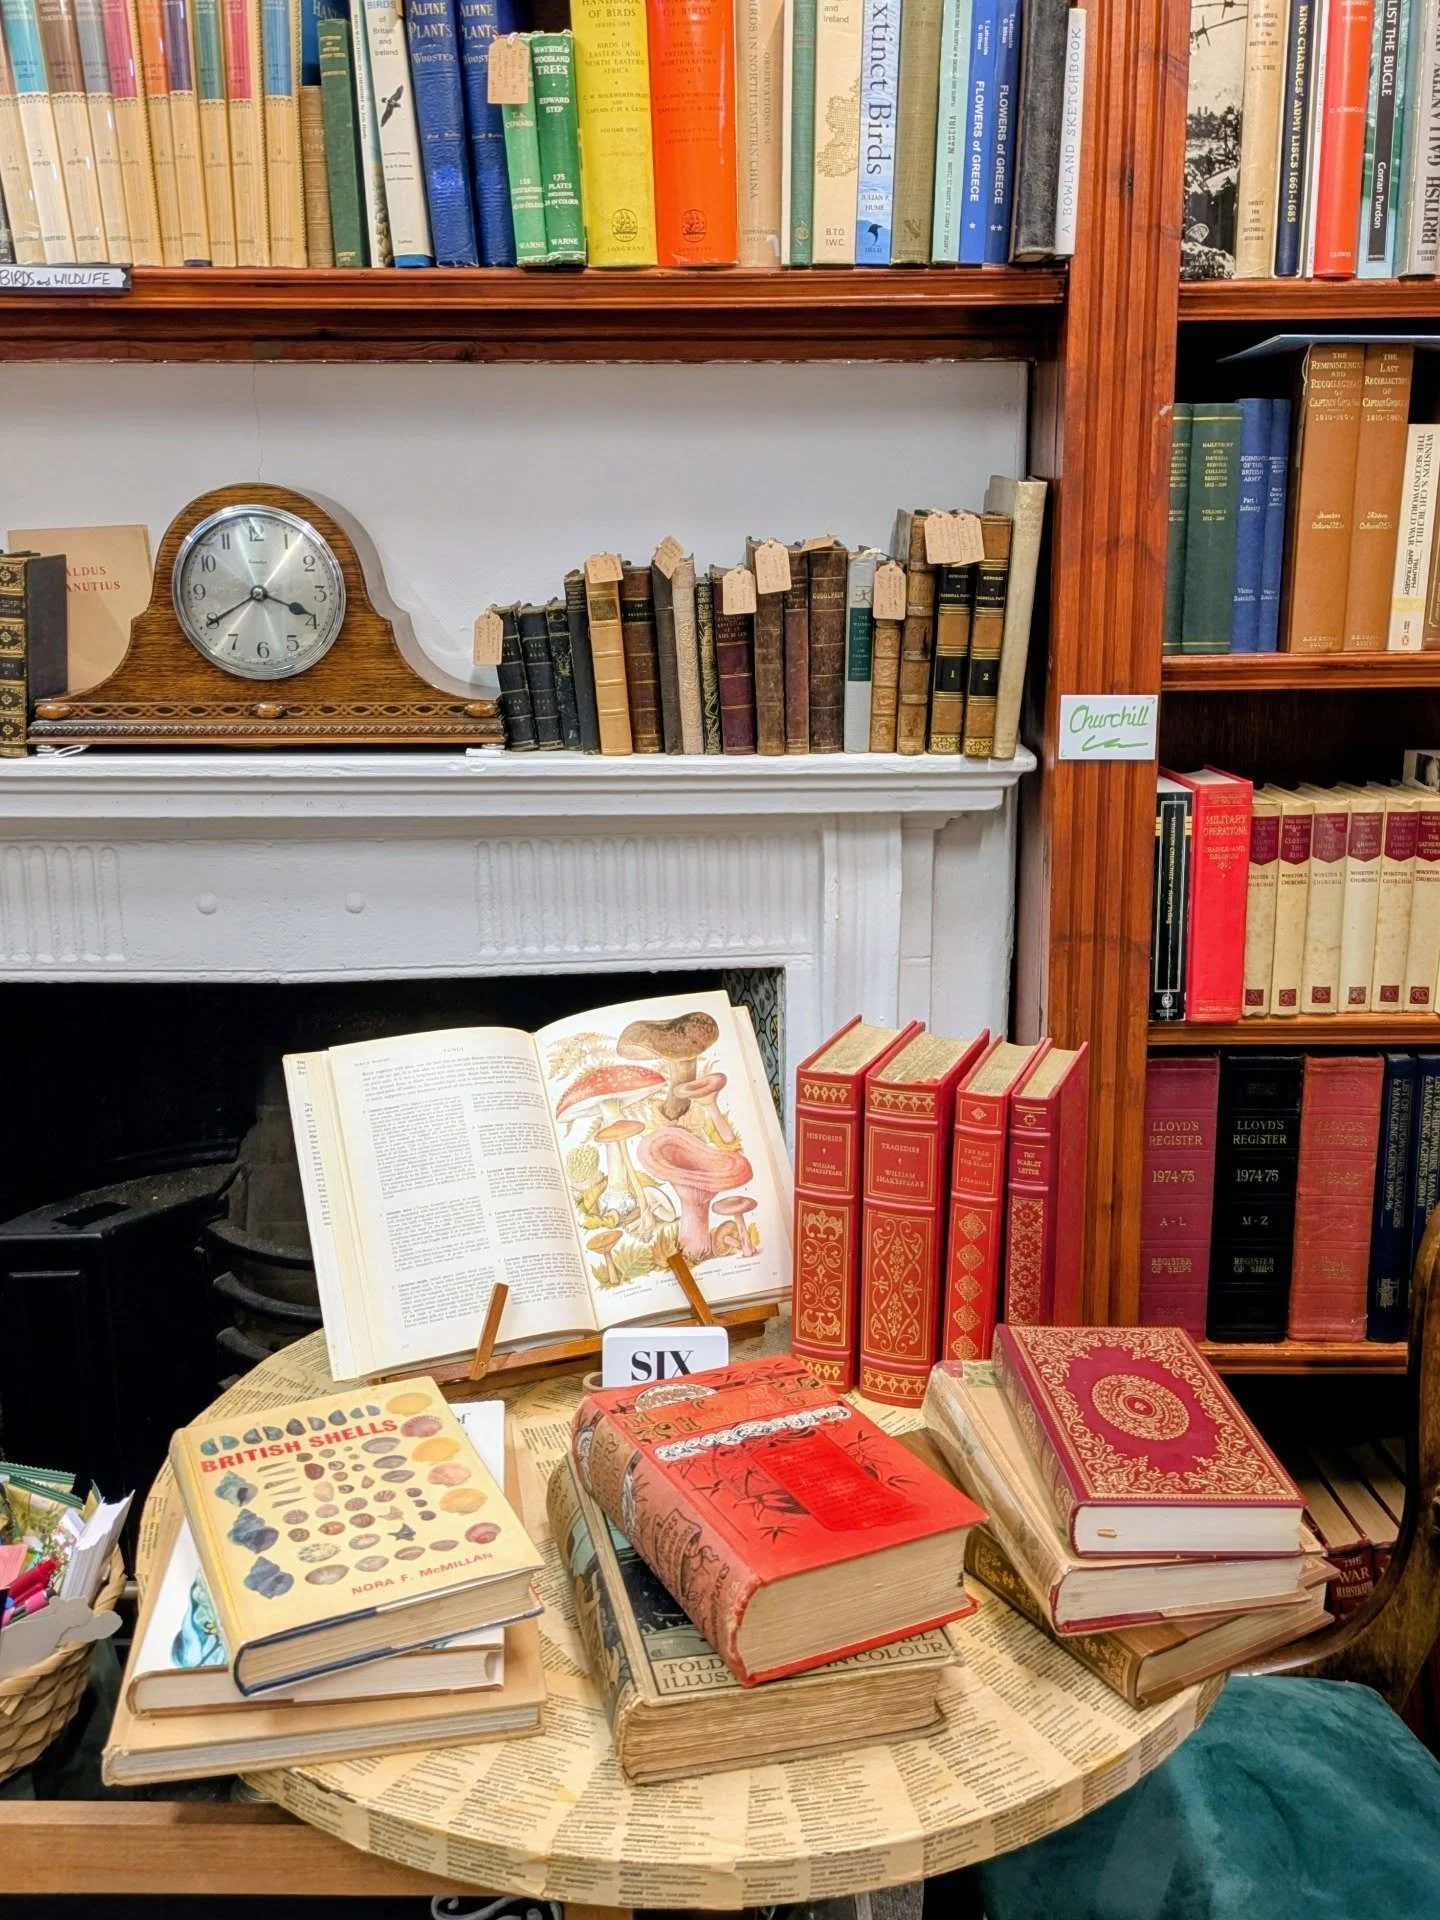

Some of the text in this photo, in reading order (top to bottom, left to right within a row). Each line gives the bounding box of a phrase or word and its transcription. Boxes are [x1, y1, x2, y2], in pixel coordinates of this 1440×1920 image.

[411, 2, 447, 16] ALPINE
[588, 8, 636, 18] OF BIRDS
[681, 7, 712, 16] BIRDS
[1298, 5, 1309, 35] KING
[407, 23, 453, 40] PLANTS
[1384, 28, 1396, 52] THE
[375, 48, 399, 56] Ireland
[534, 45, 562, 54] WAYSIDE
[589, 50, 622, 58] EASTERN
[412, 52, 456, 65] WOOSTER
[534, 56, 570, 64] WOODLAND
[614, 58, 644, 66] EASTERN
[536, 65, 568, 75] TREES
[602, 66, 629, 74] AFRICA
[1382, 56, 1394, 97] BUGLE
[539, 97, 570, 105] EDWARD
[546, 106, 563, 114] STEP
[1292, 100, 1303, 132] ARMY
[749, 37, 759, 200] IN NORTH EASTERN CHINA
[764, 132, 770, 145] ON
[867, 103, 892, 175] Birds
[948, 115, 956, 154] MADEIRA
[1062, 28, 1082, 234] A BOWLAND SKETCHBOOK
[970, 81, 985, 202] FLOWERS of GREECE
[994, 85, 1009, 204] FLOWERS of GREECE
[558, 198, 579, 206] COLOUR
[1287, 172, 1299, 223] 1661-1685
[1373, 161, 1387, 230] Corran Purdon
[1422, 176, 1440, 244] BRITISH
[518, 241, 546, 250] WARNE
[551, 238, 579, 246] WARNE
[0, 270, 111, 287] BIRDS and WILDLIFE
[1380, 363, 1400, 373] LAST
[1423, 434, 1434, 478] WINSTON
[1408, 434, 1426, 546] THE SECOND WORLD WAR
[222, 534, 230, 550] 11
[249, 526, 264, 542] 12
[284, 534, 288, 550] 1
[201, 554, 216, 572] 10
[303, 555, 316, 572] 2
[1404, 566, 1412, 596] TRAGEDY
[1411, 558, 1419, 589] TRIUMPH
[65, 580, 120, 592] ANUTIUS
[193, 584, 206, 600] 9
[314, 586, 328, 602] 3
[206, 612, 220, 630] 8
[304, 614, 320, 630] 4
[228, 634, 239, 650] 7
[256, 642, 270, 658] 6
[286, 634, 300, 652] 5
[951, 670, 955, 678] 1
[982, 672, 990, 680] 2
[1070, 704, 1149, 733] Churchill
[1206, 814, 1248, 824] MILITARY
[1204, 826, 1247, 836] OPERATIONS
[1152, 1120, 1200, 1132] LLOYD'S
[1236, 1120, 1284, 1131] LLOYD'S
[1420, 1084, 1434, 1177] MANAGING AGENTS
[806, 1132, 844, 1142] HISTORIES
[1149, 1134, 1202, 1146] REGISTER
[1232, 1134, 1287, 1145] REGISTER
[880, 1142, 920, 1154] TRAGEDIES
[1384, 1086, 1401, 1211] MANAGING AGENTS 1995-96
[806, 1166, 842, 1176] SHAKESPEARE
[812, 1162, 836, 1170] WILLIAM
[1016, 1159, 1042, 1168] SCARLET
[884, 1170, 916, 1178] WILLIAM
[1018, 1168, 1040, 1176] LETTER
[876, 1176, 924, 1188] SHAKESPEARE
[1242, 1216, 1268, 1226] M Z
[1152, 1258, 1192, 1266] REGISTER
[1234, 1258, 1274, 1266] REGISTER
[631, 1350, 694, 1381] SIX
[201, 1420, 398, 1474] BRITISH SHELLS
[1344, 1556, 1362, 1568] THE
[352, 1552, 494, 1596] NORA F. McMILLAN
[1340, 1566, 1370, 1584] WAR
[1336, 1581, 1374, 1597] ILLUSTRAT
[663, 1658, 724, 1675] TOLD
